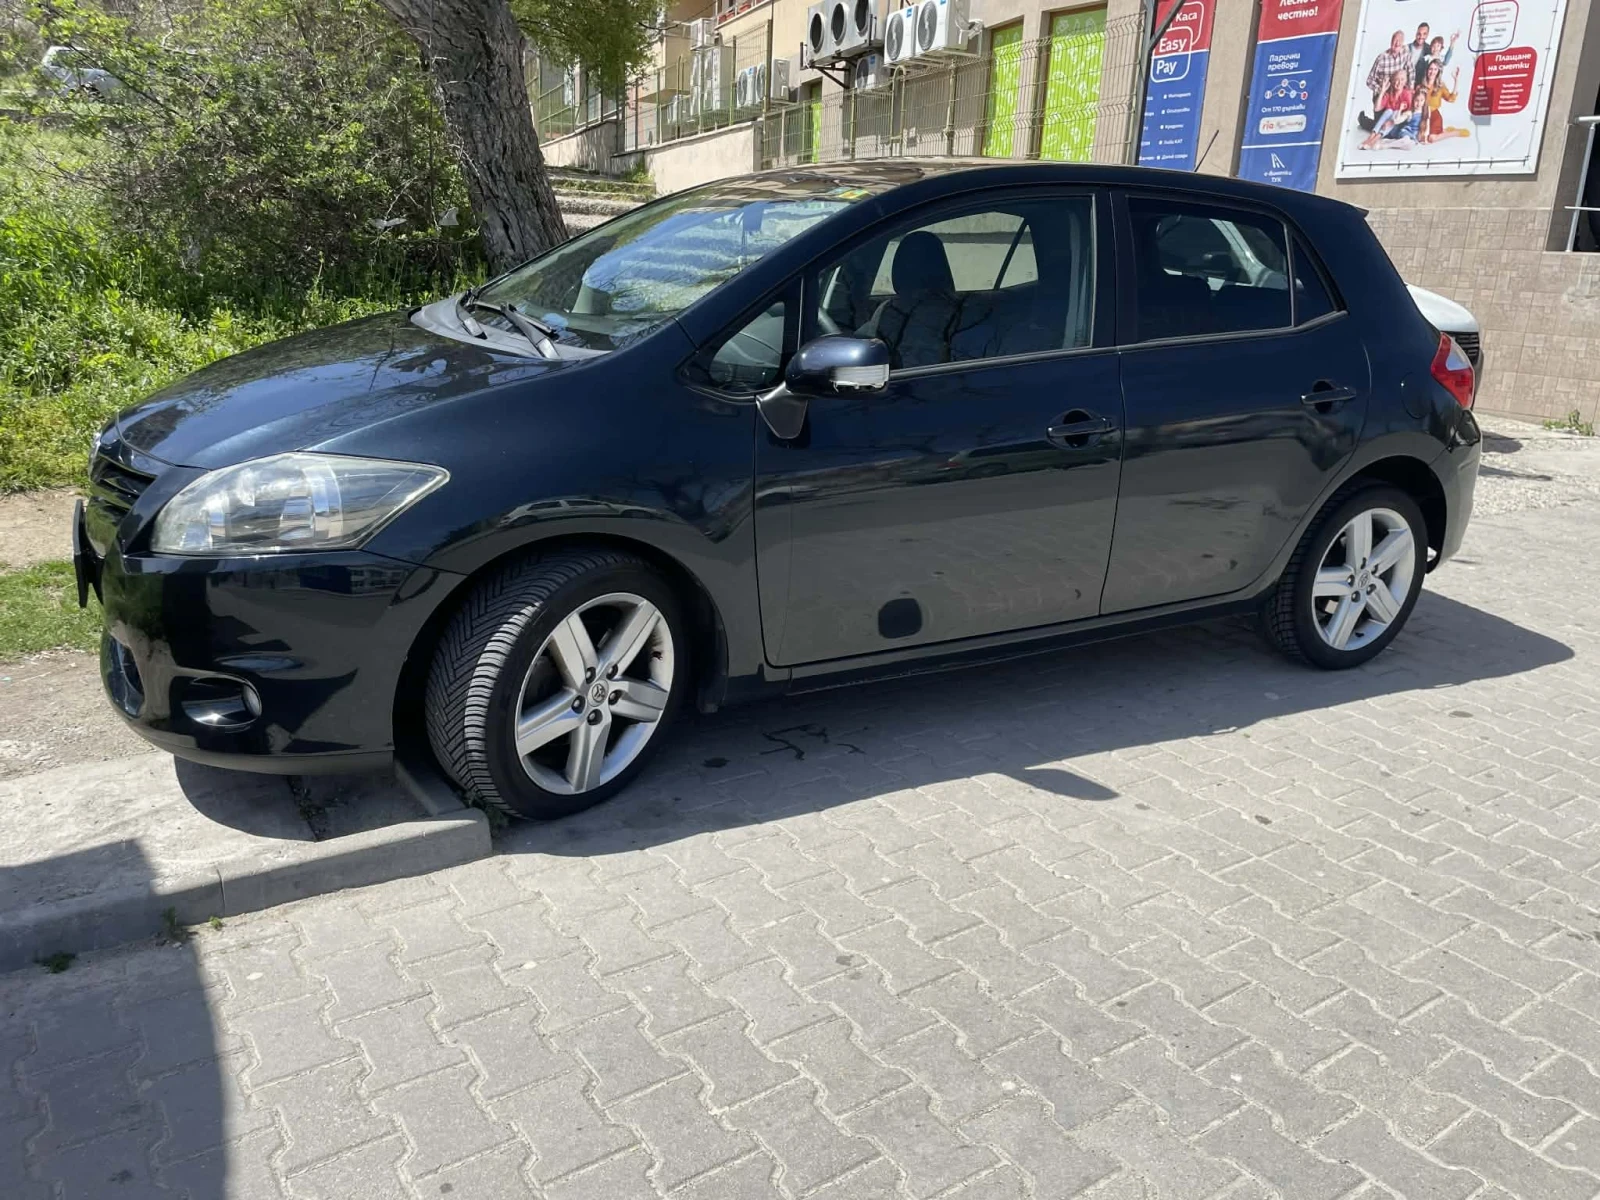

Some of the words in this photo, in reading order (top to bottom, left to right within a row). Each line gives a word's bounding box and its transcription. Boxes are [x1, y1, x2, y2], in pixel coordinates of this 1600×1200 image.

[1176, 12, 1197, 22] Каса
[1277, 6, 1318, 20] честно!
[1159, 38, 1187, 52] Easy
[1269, 52, 1301, 63] Парични
[1495, 53, 1532, 62] Плащане
[1156, 60, 1177, 75] Pay
[1267, 61, 1299, 71] преводи
[1498, 61, 1530, 71] сметки
